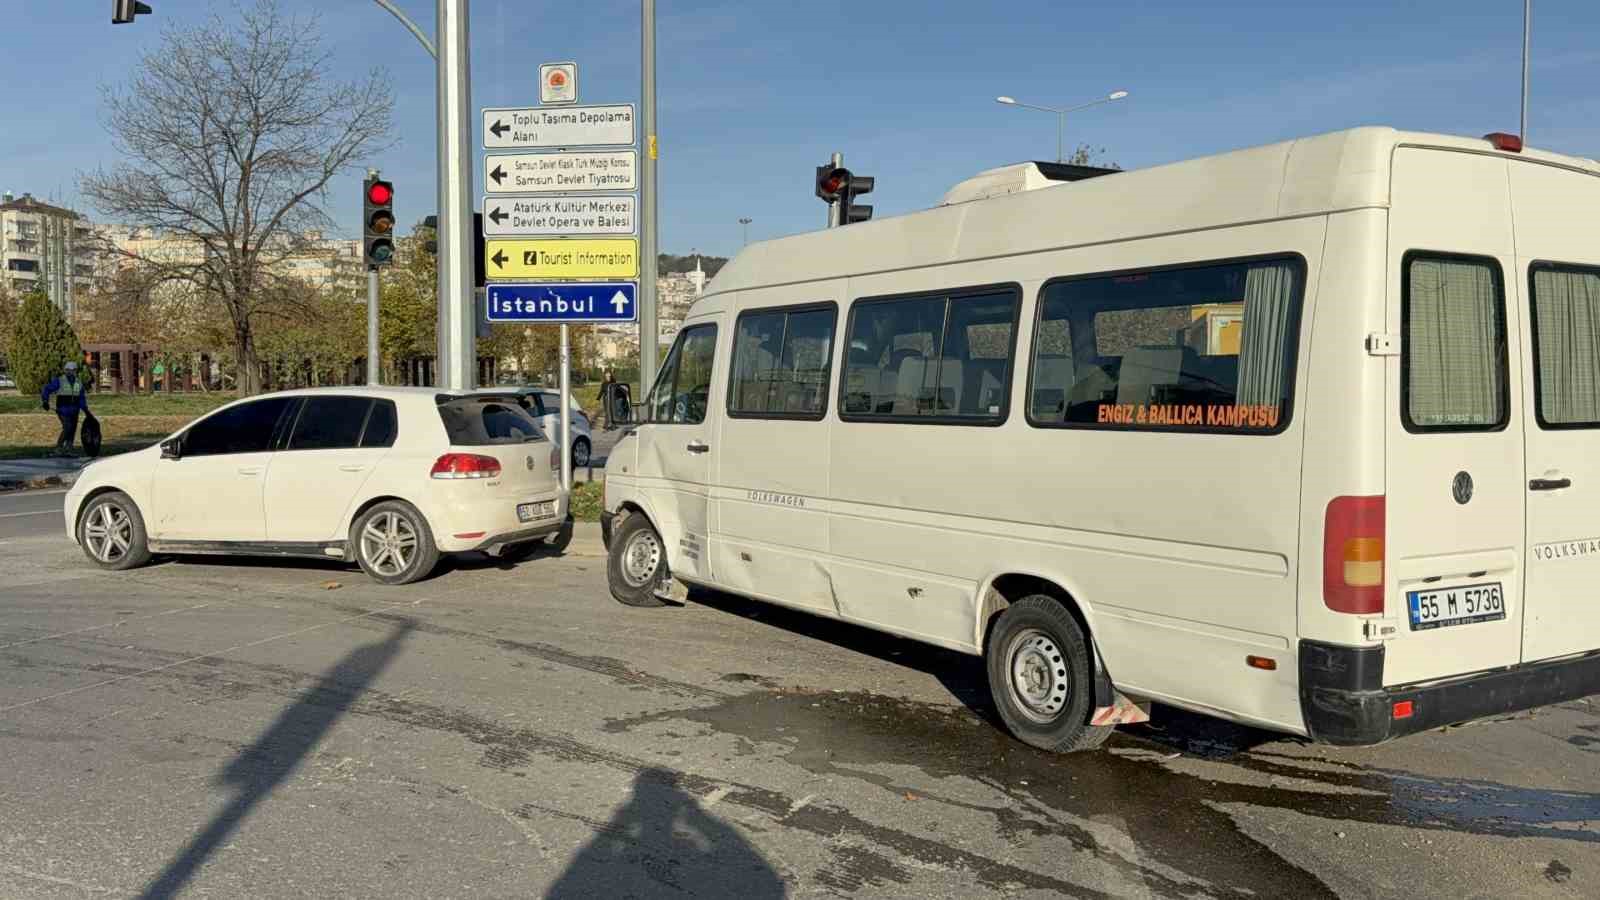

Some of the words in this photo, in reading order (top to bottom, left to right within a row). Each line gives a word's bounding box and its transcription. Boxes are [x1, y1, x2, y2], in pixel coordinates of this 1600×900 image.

[512, 113, 540, 127] Toplu
[579, 111, 631, 126] Depolama
[515, 175, 553, 186] Samsun
[557, 173, 586, 185] Devlet
[589, 199, 630, 212] Merkezi
[513, 216, 546, 228] Devlet
[548, 216, 580, 230] Opera
[583, 219, 595, 228] ve
[598, 215, 630, 228] Balesi
[540, 251, 572, 265] Tourist
[492, 292, 594, 313] İstanbul
[1136, 404, 1147, 424] &
[1149, 404, 1203, 425] BALLICA
[1420, 594, 1439, 619] 55
[1447, 592, 1458, 616] M
[1465, 588, 1500, 614] 5736
